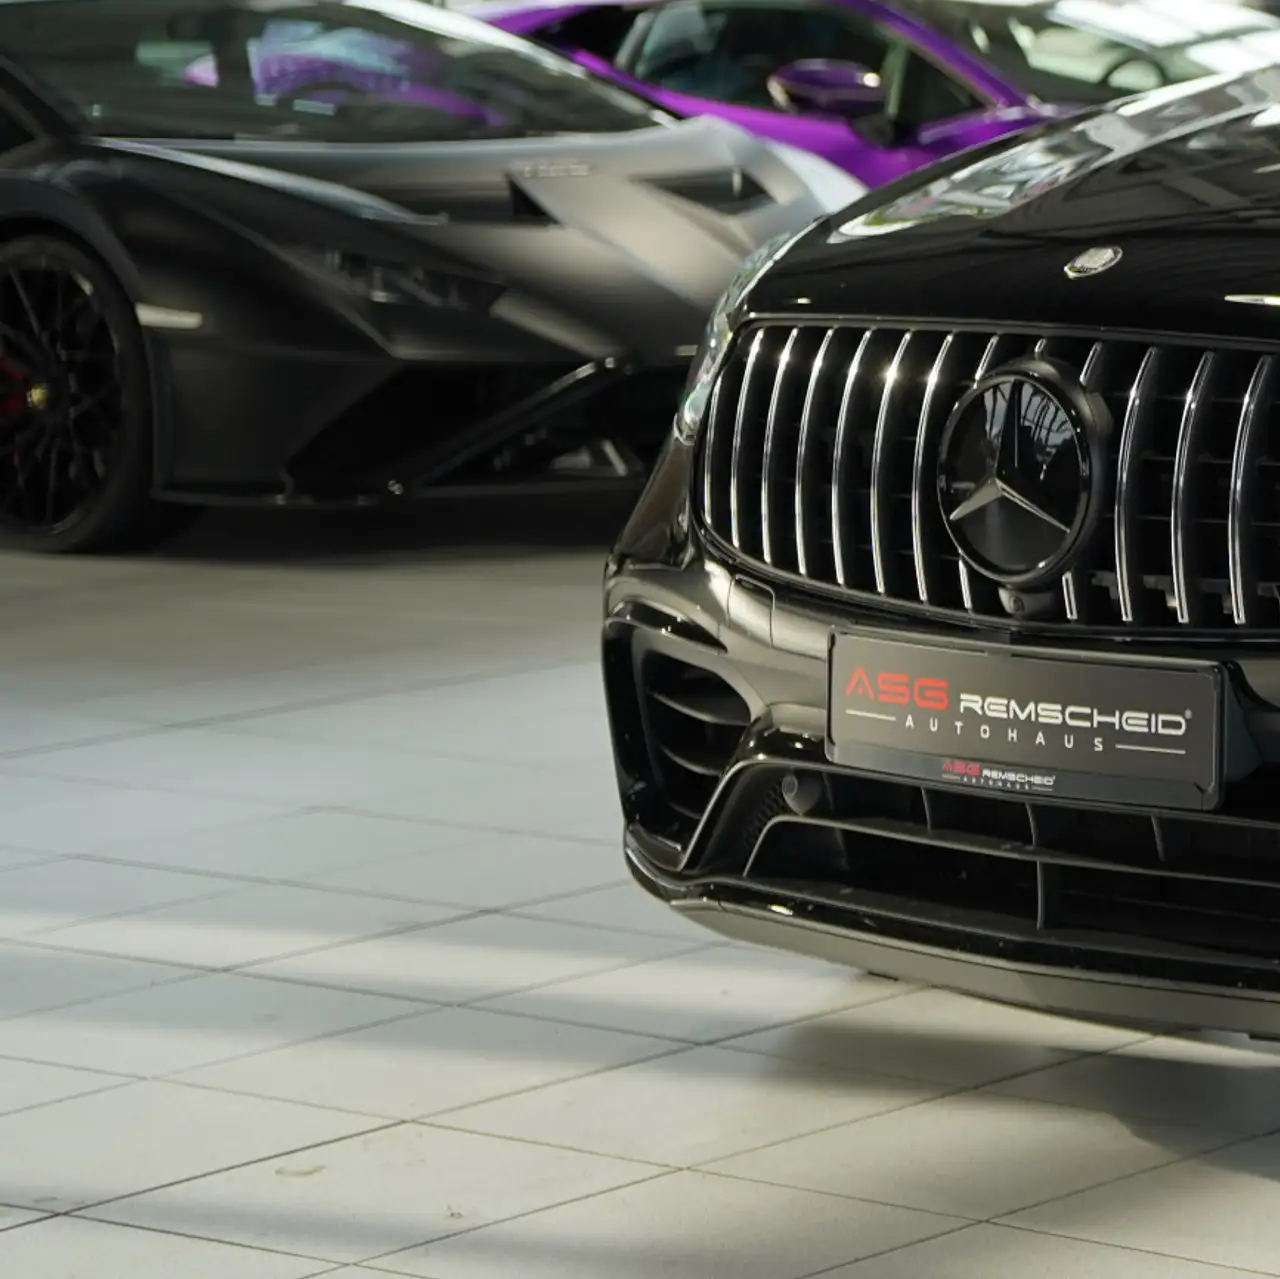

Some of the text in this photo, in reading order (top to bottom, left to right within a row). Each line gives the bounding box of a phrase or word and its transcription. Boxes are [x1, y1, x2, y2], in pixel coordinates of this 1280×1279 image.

[846, 667, 949, 710] ASG
[904, 714, 1104, 752] AUTOHAUS
[941, 760, 981, 776] ASG
